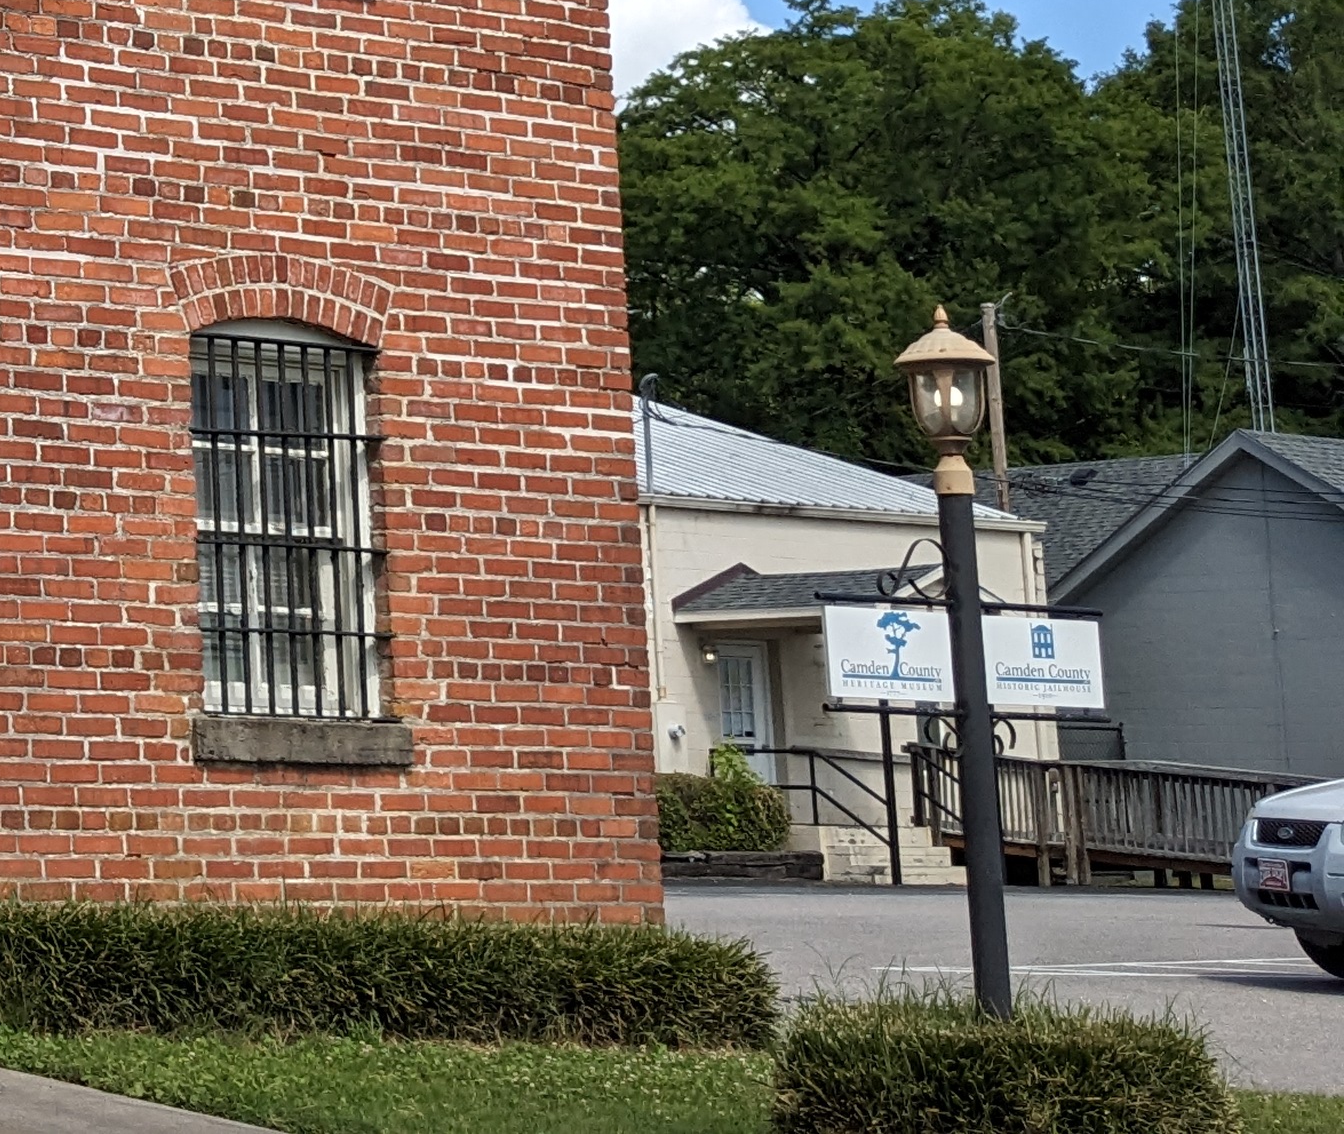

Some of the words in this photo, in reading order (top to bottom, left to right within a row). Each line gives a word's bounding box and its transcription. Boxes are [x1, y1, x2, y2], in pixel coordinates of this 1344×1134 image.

[840, 659, 889, 675] Camden
[899, 662, 942, 677] County
[995, 661, 1045, 677] Camden
[1048, 663, 1091, 679] County
[842, 679, 894, 689] HERITAGE
[901, 682, 943, 691] MUSEUM
[996, 682, 1041, 691] HISTORIC
[1043, 684, 1091, 693] JAILHOUSE
